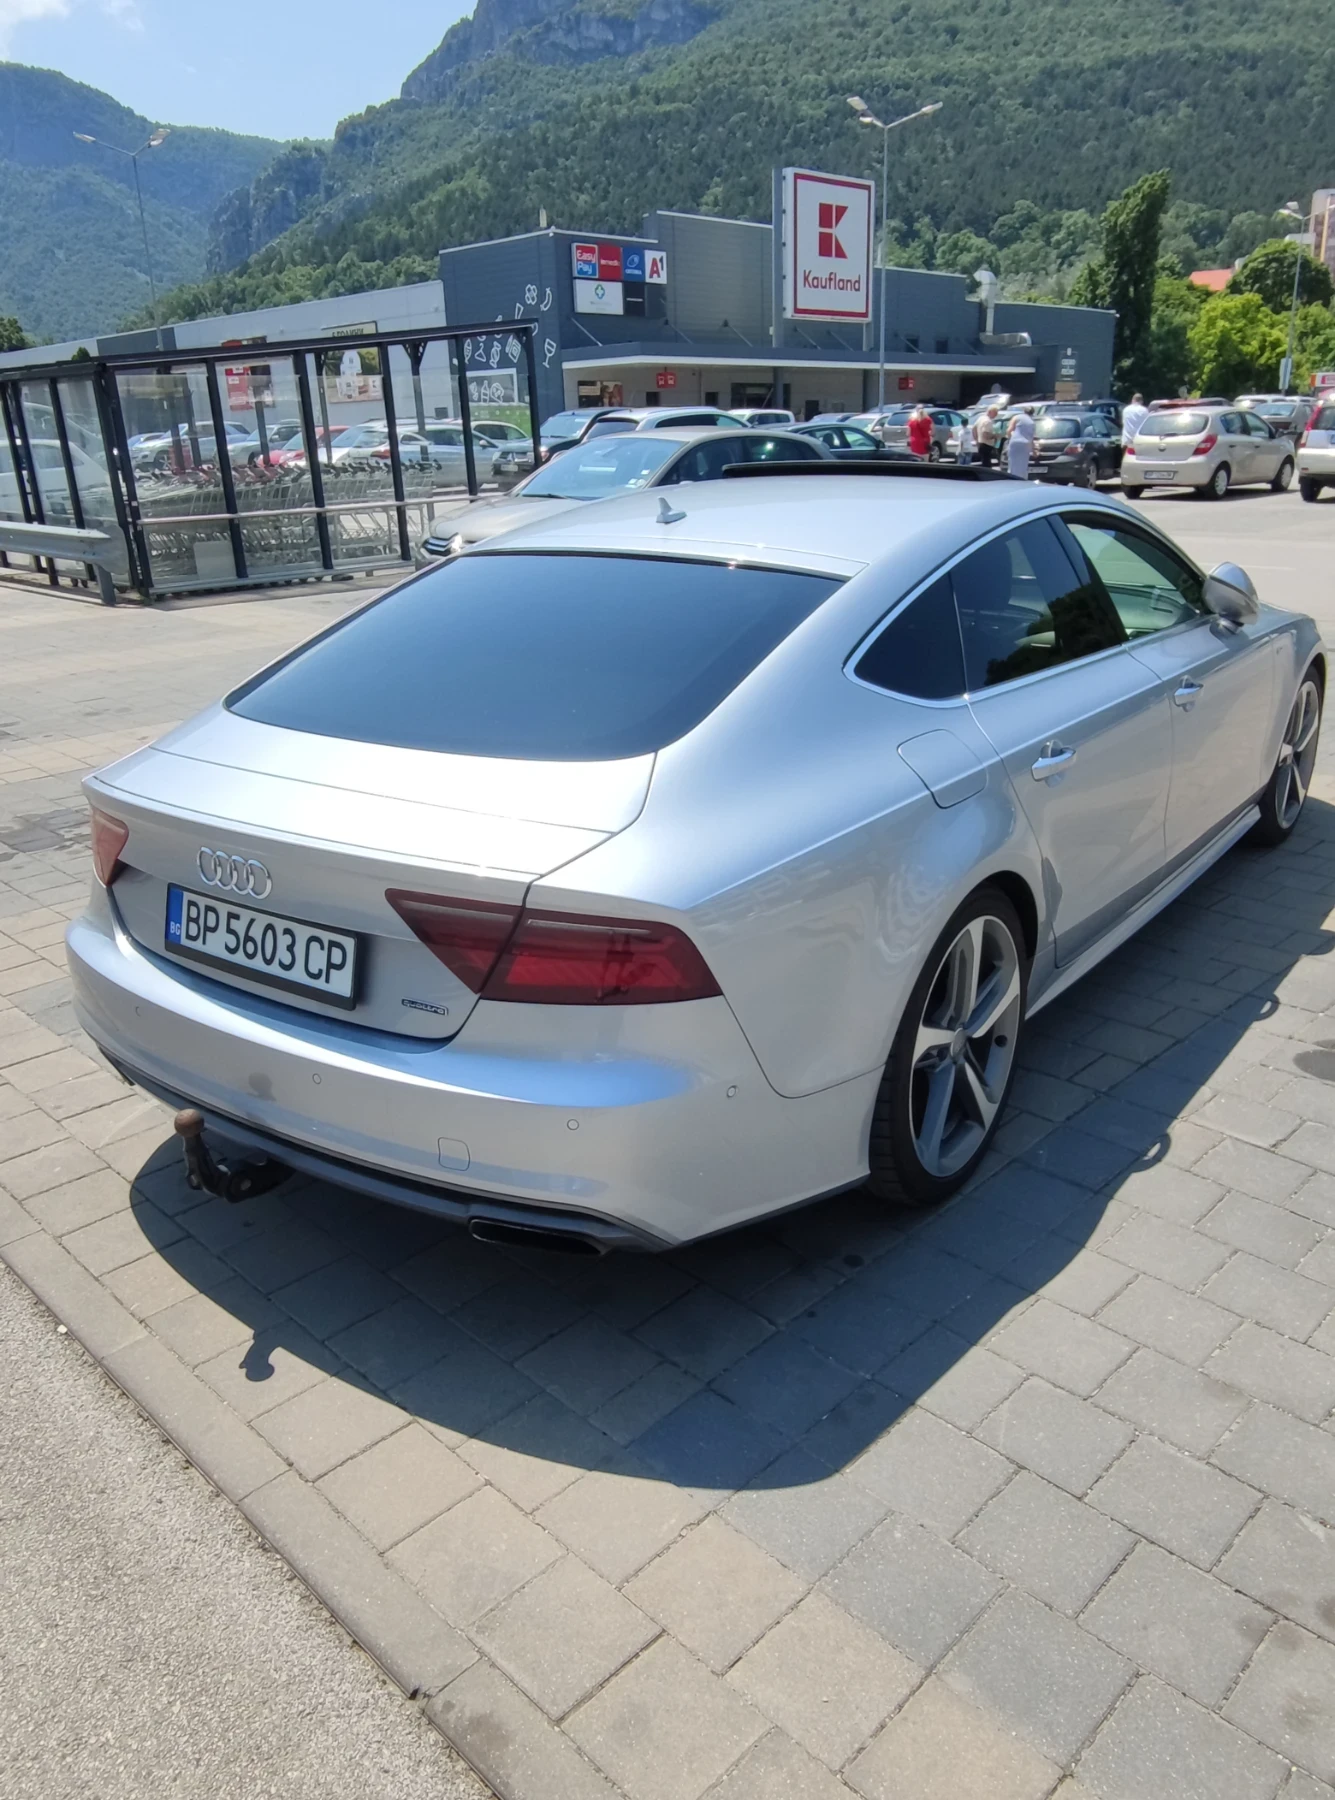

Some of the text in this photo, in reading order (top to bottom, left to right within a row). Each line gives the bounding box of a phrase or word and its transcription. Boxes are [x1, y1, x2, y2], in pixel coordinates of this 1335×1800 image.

[576, 250, 596, 263] Easy
[577, 262, 592, 275] Pay
[649, 255, 664, 279] A1
[803, 269, 861, 292] Kaufland
[170, 921, 181, 936] BG
[184, 899, 347, 984] BP 5603 CP
[403, 1000, 445, 1014] quattro
